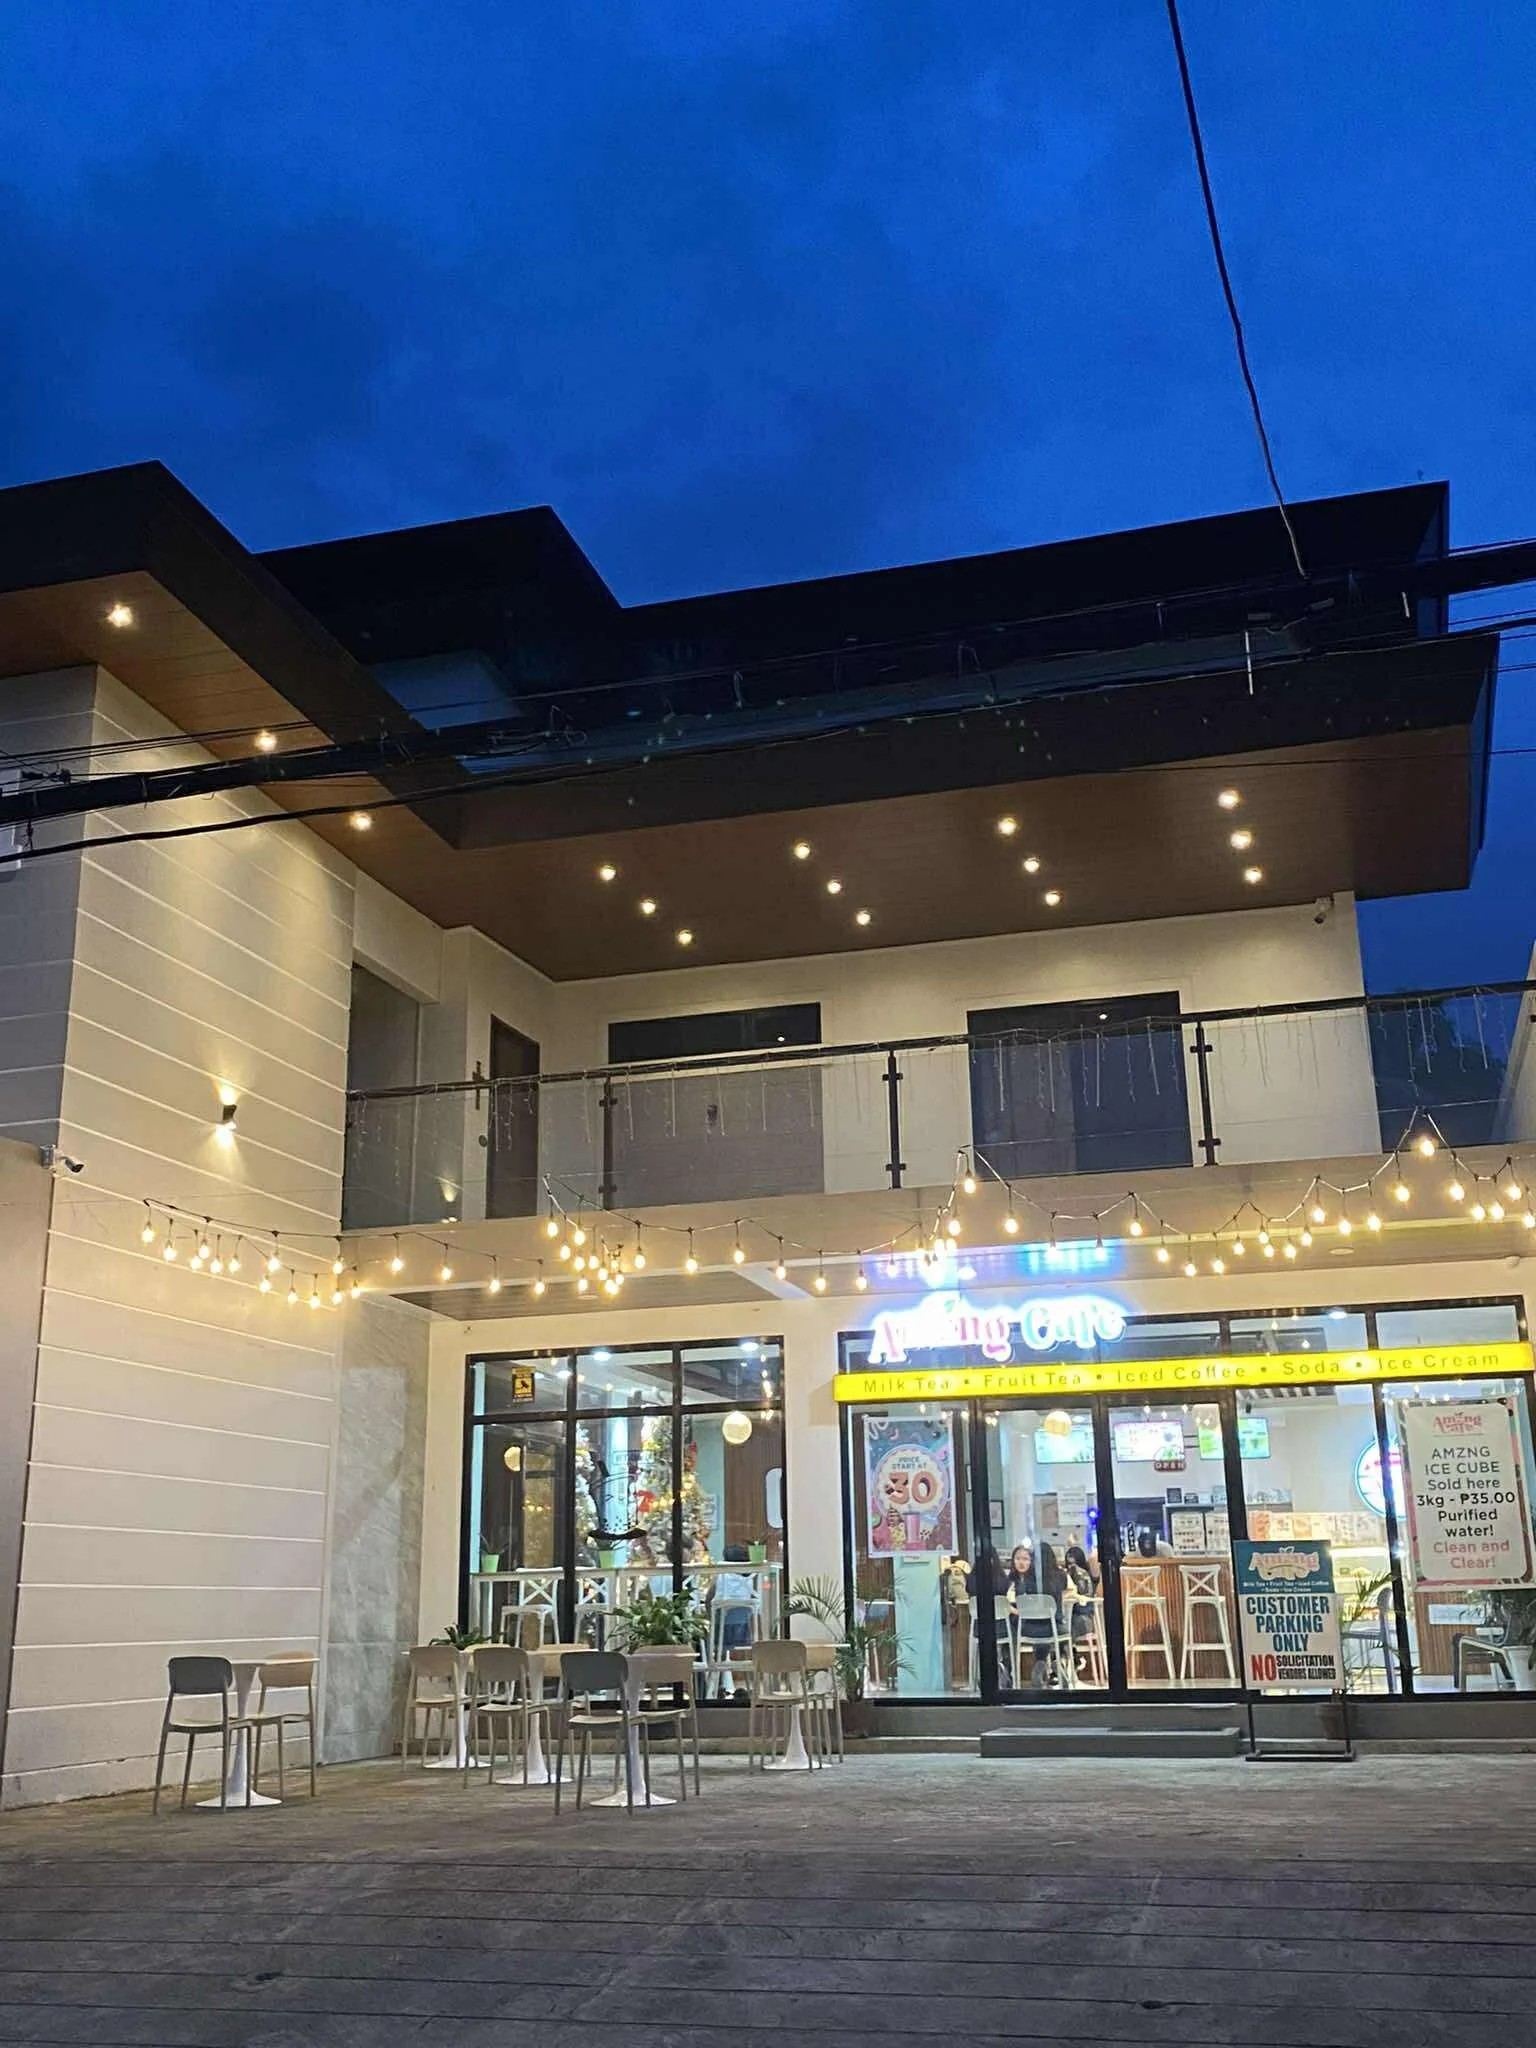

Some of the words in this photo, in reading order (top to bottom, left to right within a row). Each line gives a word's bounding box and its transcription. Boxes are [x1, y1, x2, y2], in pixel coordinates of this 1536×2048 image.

[868, 1308, 1014, 1363] Ang
[863, 1374, 905, 1393] Milk
[915, 1376, 950, 1391] Tea
[983, 1373, 1037, 1388] Fruit
[1045, 1371, 1082, 1386] Tea
[1116, 1368, 1164, 1384] Iced
[1173, 1364, 1246, 1382] Coffee
[1282, 1360, 1341, 1376] Soda
[1378, 1356, 1413, 1371] Ice
[1423, 1352, 1500, 1369] Cream
[1431, 1446, 1490, 1459] AMZNG
[1425, 1463, 1451, 1475] ICE
[1456, 1461, 1500, 1474] CUBE
[885, 1471, 937, 1505] 30
[1427, 1478, 1462, 1491] Sold
[1467, 1476, 1500, 1489] here
[1416, 1495, 1444, 1508] 3kg
[1438, 1508, 1498, 1522] Purified
[1445, 1524, 1494, 1537] water!
[1433, 1541, 1477, 1553] Clean
[1482, 1539, 1510, 1552] and
[1450, 1556, 1496, 1569] Clear!
[1246, 1596, 1330, 1615] CUSTOMER
[1256, 1614, 1323, 1633] PARKING
[1273, 1633, 1309, 1652] ONLY
[1250, 1654, 1277, 1681] NO
[1276, 1654, 1335, 1667] SOLICITATION
